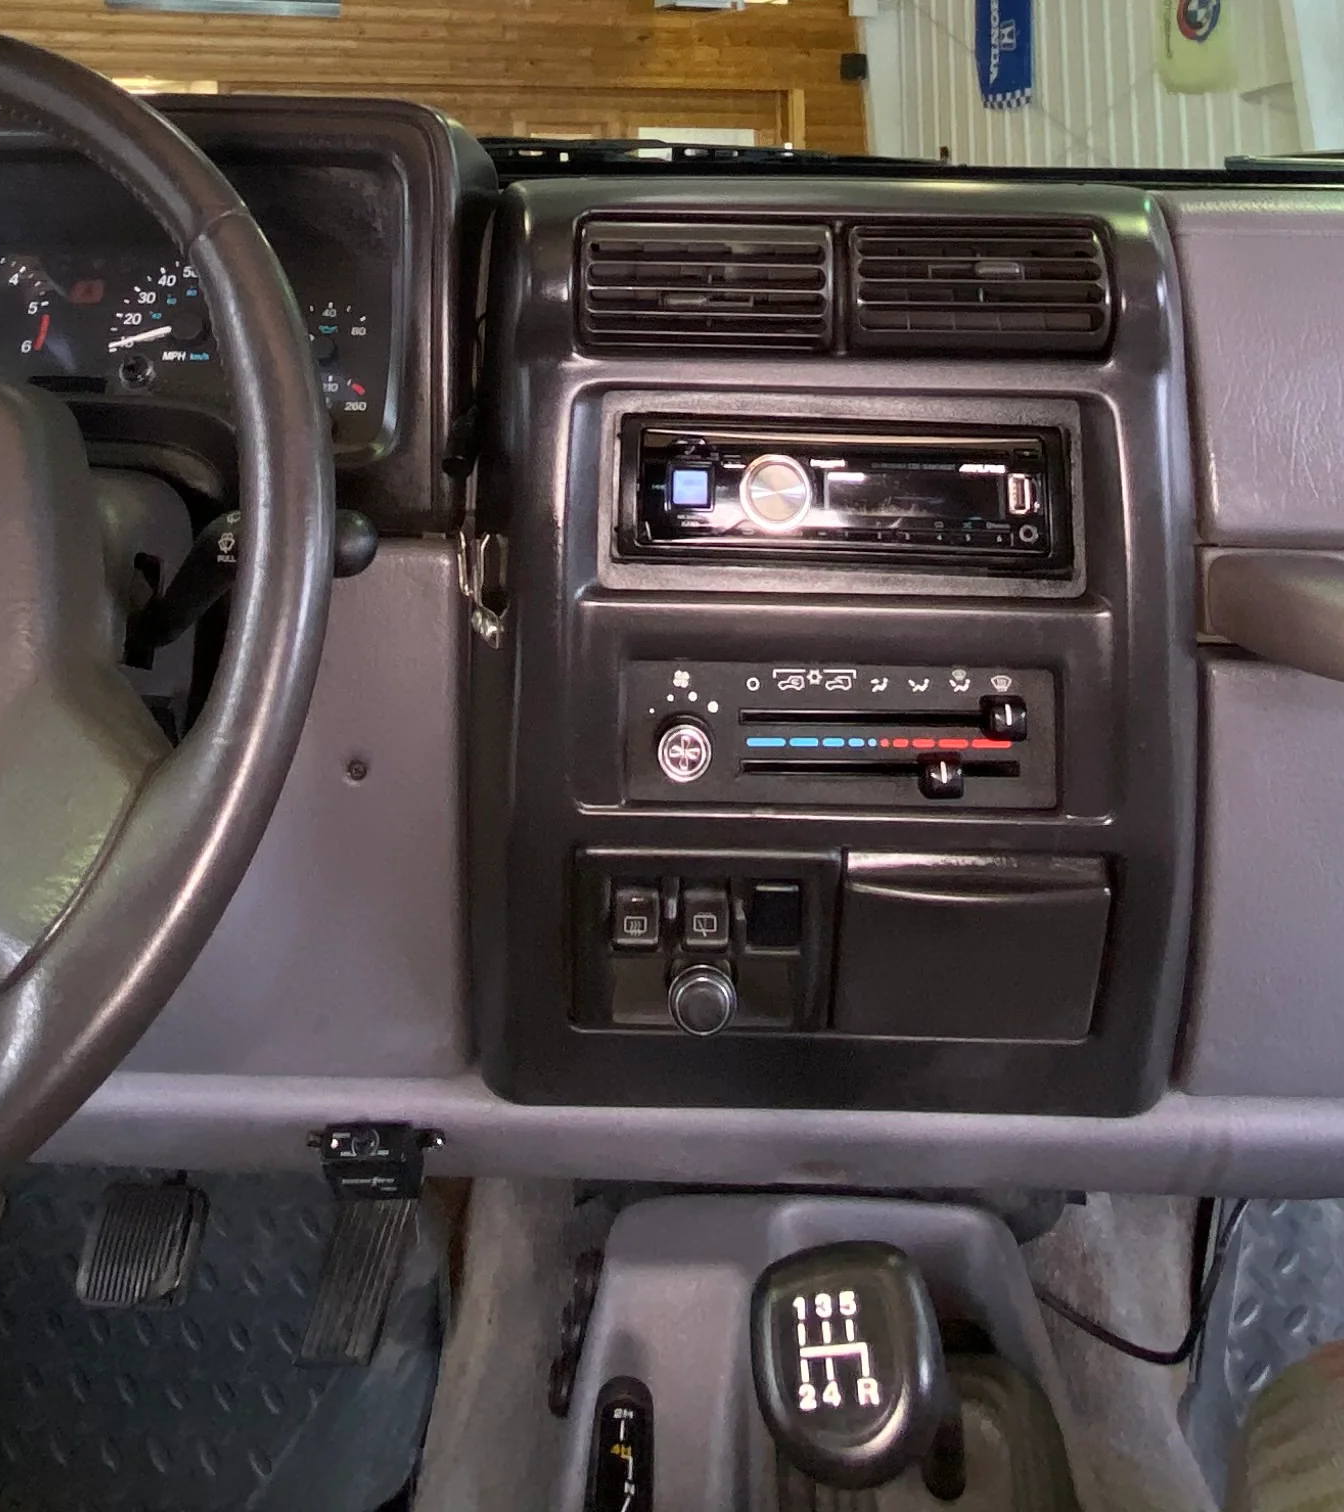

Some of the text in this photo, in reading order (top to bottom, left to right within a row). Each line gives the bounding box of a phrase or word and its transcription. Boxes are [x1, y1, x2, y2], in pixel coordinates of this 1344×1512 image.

[8, 273, 19, 287] 4
[157, 275, 177, 287] 40
[137, 292, 156, 305] 30
[27, 301, 38, 315] 5
[321, 308, 337, 318] 40
[123, 313, 142, 325] 20
[20, 340, 32, 354] 6
[161, 350, 186, 361] MPH
[343, 400, 368, 412] 260
[792, 1290, 857, 1320] 1 3 5
[799, 1377, 880, 1411] 2 4 R
[624, 1480, 636, 1496] N
